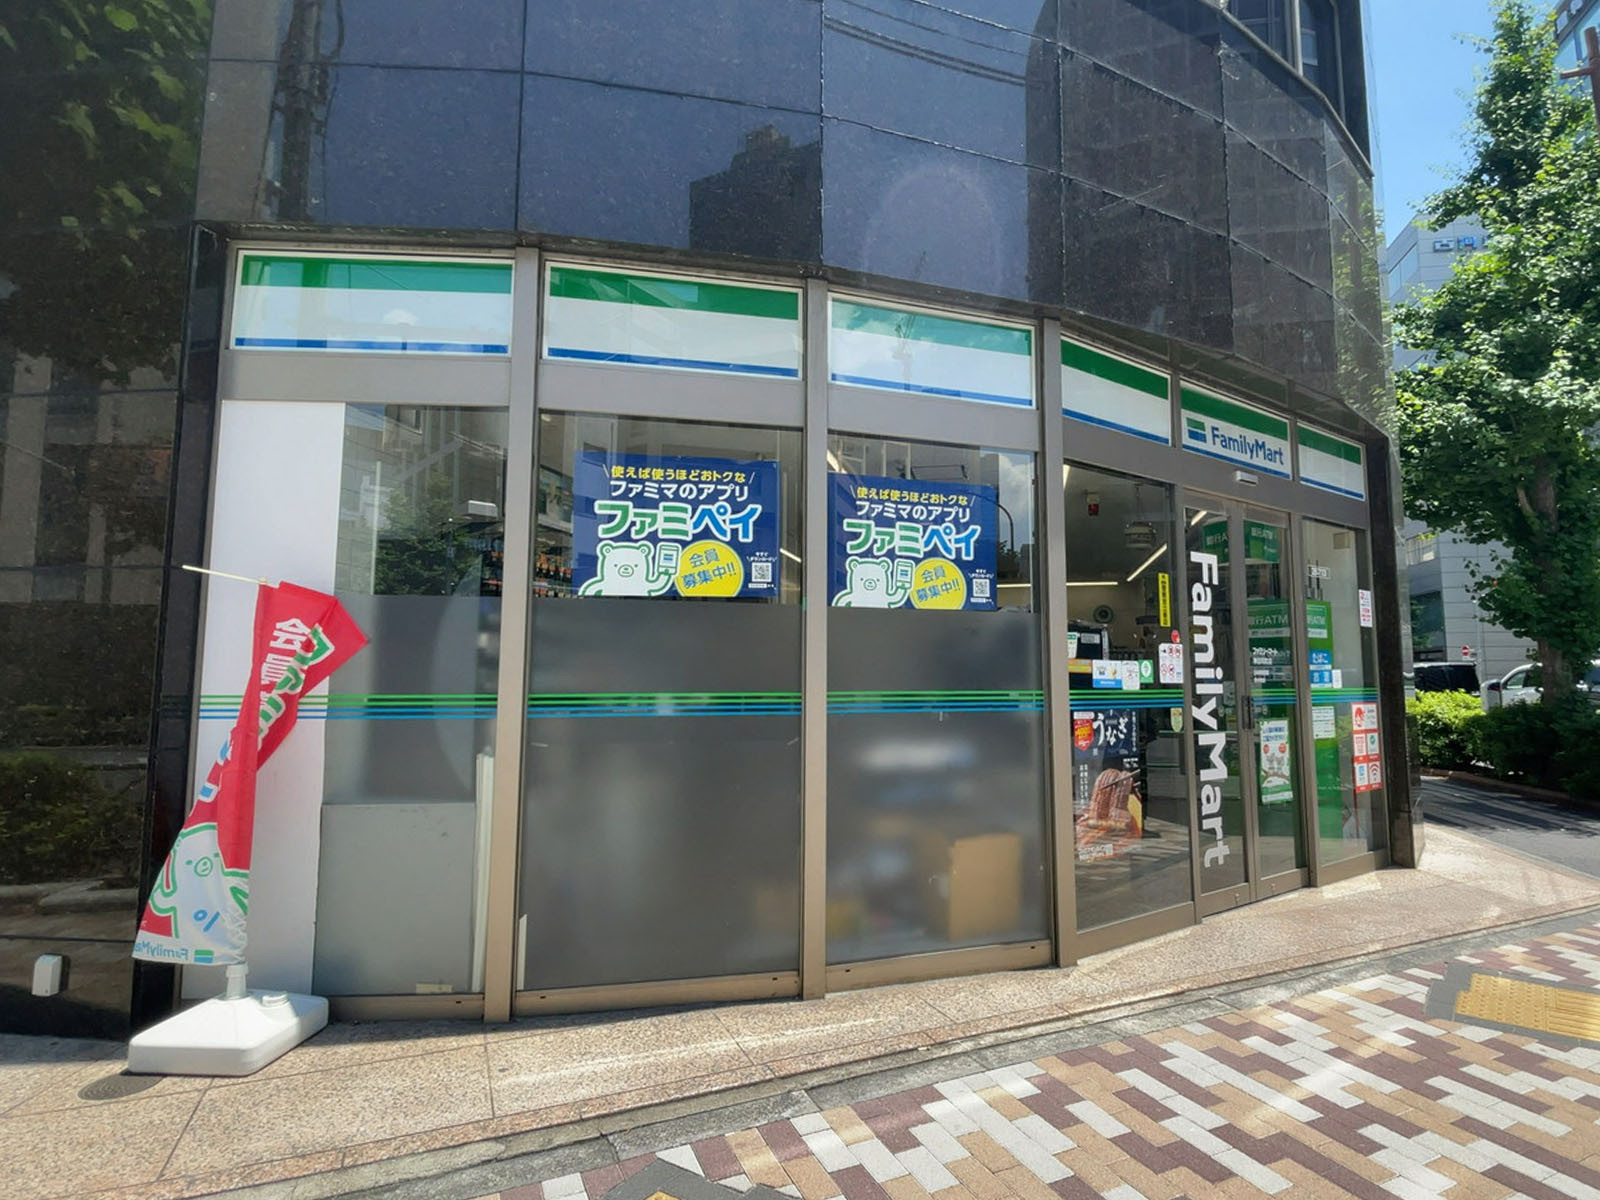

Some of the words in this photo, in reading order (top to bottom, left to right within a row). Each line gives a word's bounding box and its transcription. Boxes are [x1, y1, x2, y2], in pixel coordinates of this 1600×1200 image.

[1210, 425, 1284, 465] FamilyMart
[611, 464, 747, 483] 使えば使うほどおトクな
[609, 480, 750, 502] ファミマのアプリ
[856, 486, 968, 506] 使えば使うほどおトクな
[594, 500, 763, 544] ファミペイ
[855, 500, 971, 524] ファミマのアプリ
[843, 518, 982, 561] ファミペイ
[689, 547, 721, 569] 会員
[920, 565, 946, 583] 会員
[1189, 550, 1231, 869] FamilyMart
[1092, 712, 1129, 747] うなぎ
